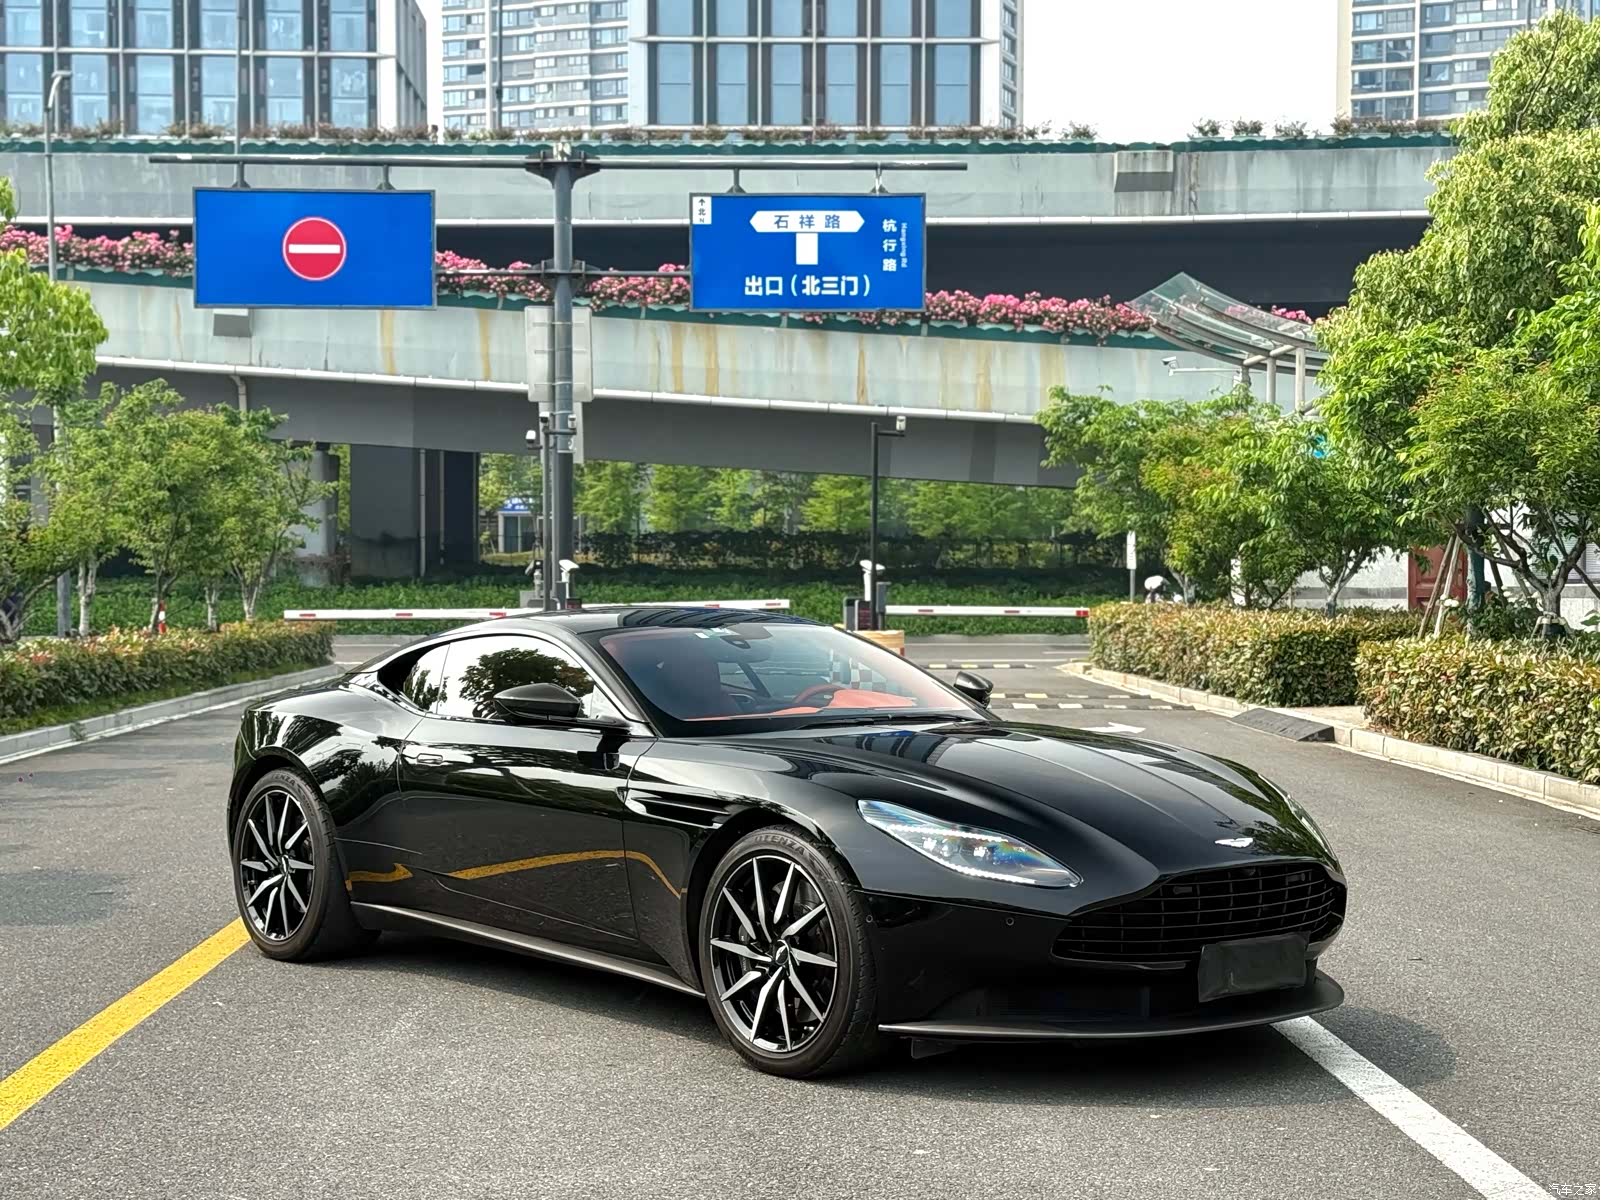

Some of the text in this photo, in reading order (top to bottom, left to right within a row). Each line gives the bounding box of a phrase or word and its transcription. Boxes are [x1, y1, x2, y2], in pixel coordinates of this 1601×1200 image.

[698, 207, 706, 216] 北
[774, 214, 841, 229] 石祥路
[882, 218, 898, 272] 杭行路
[750, 834, 805, 856] OTENZA
